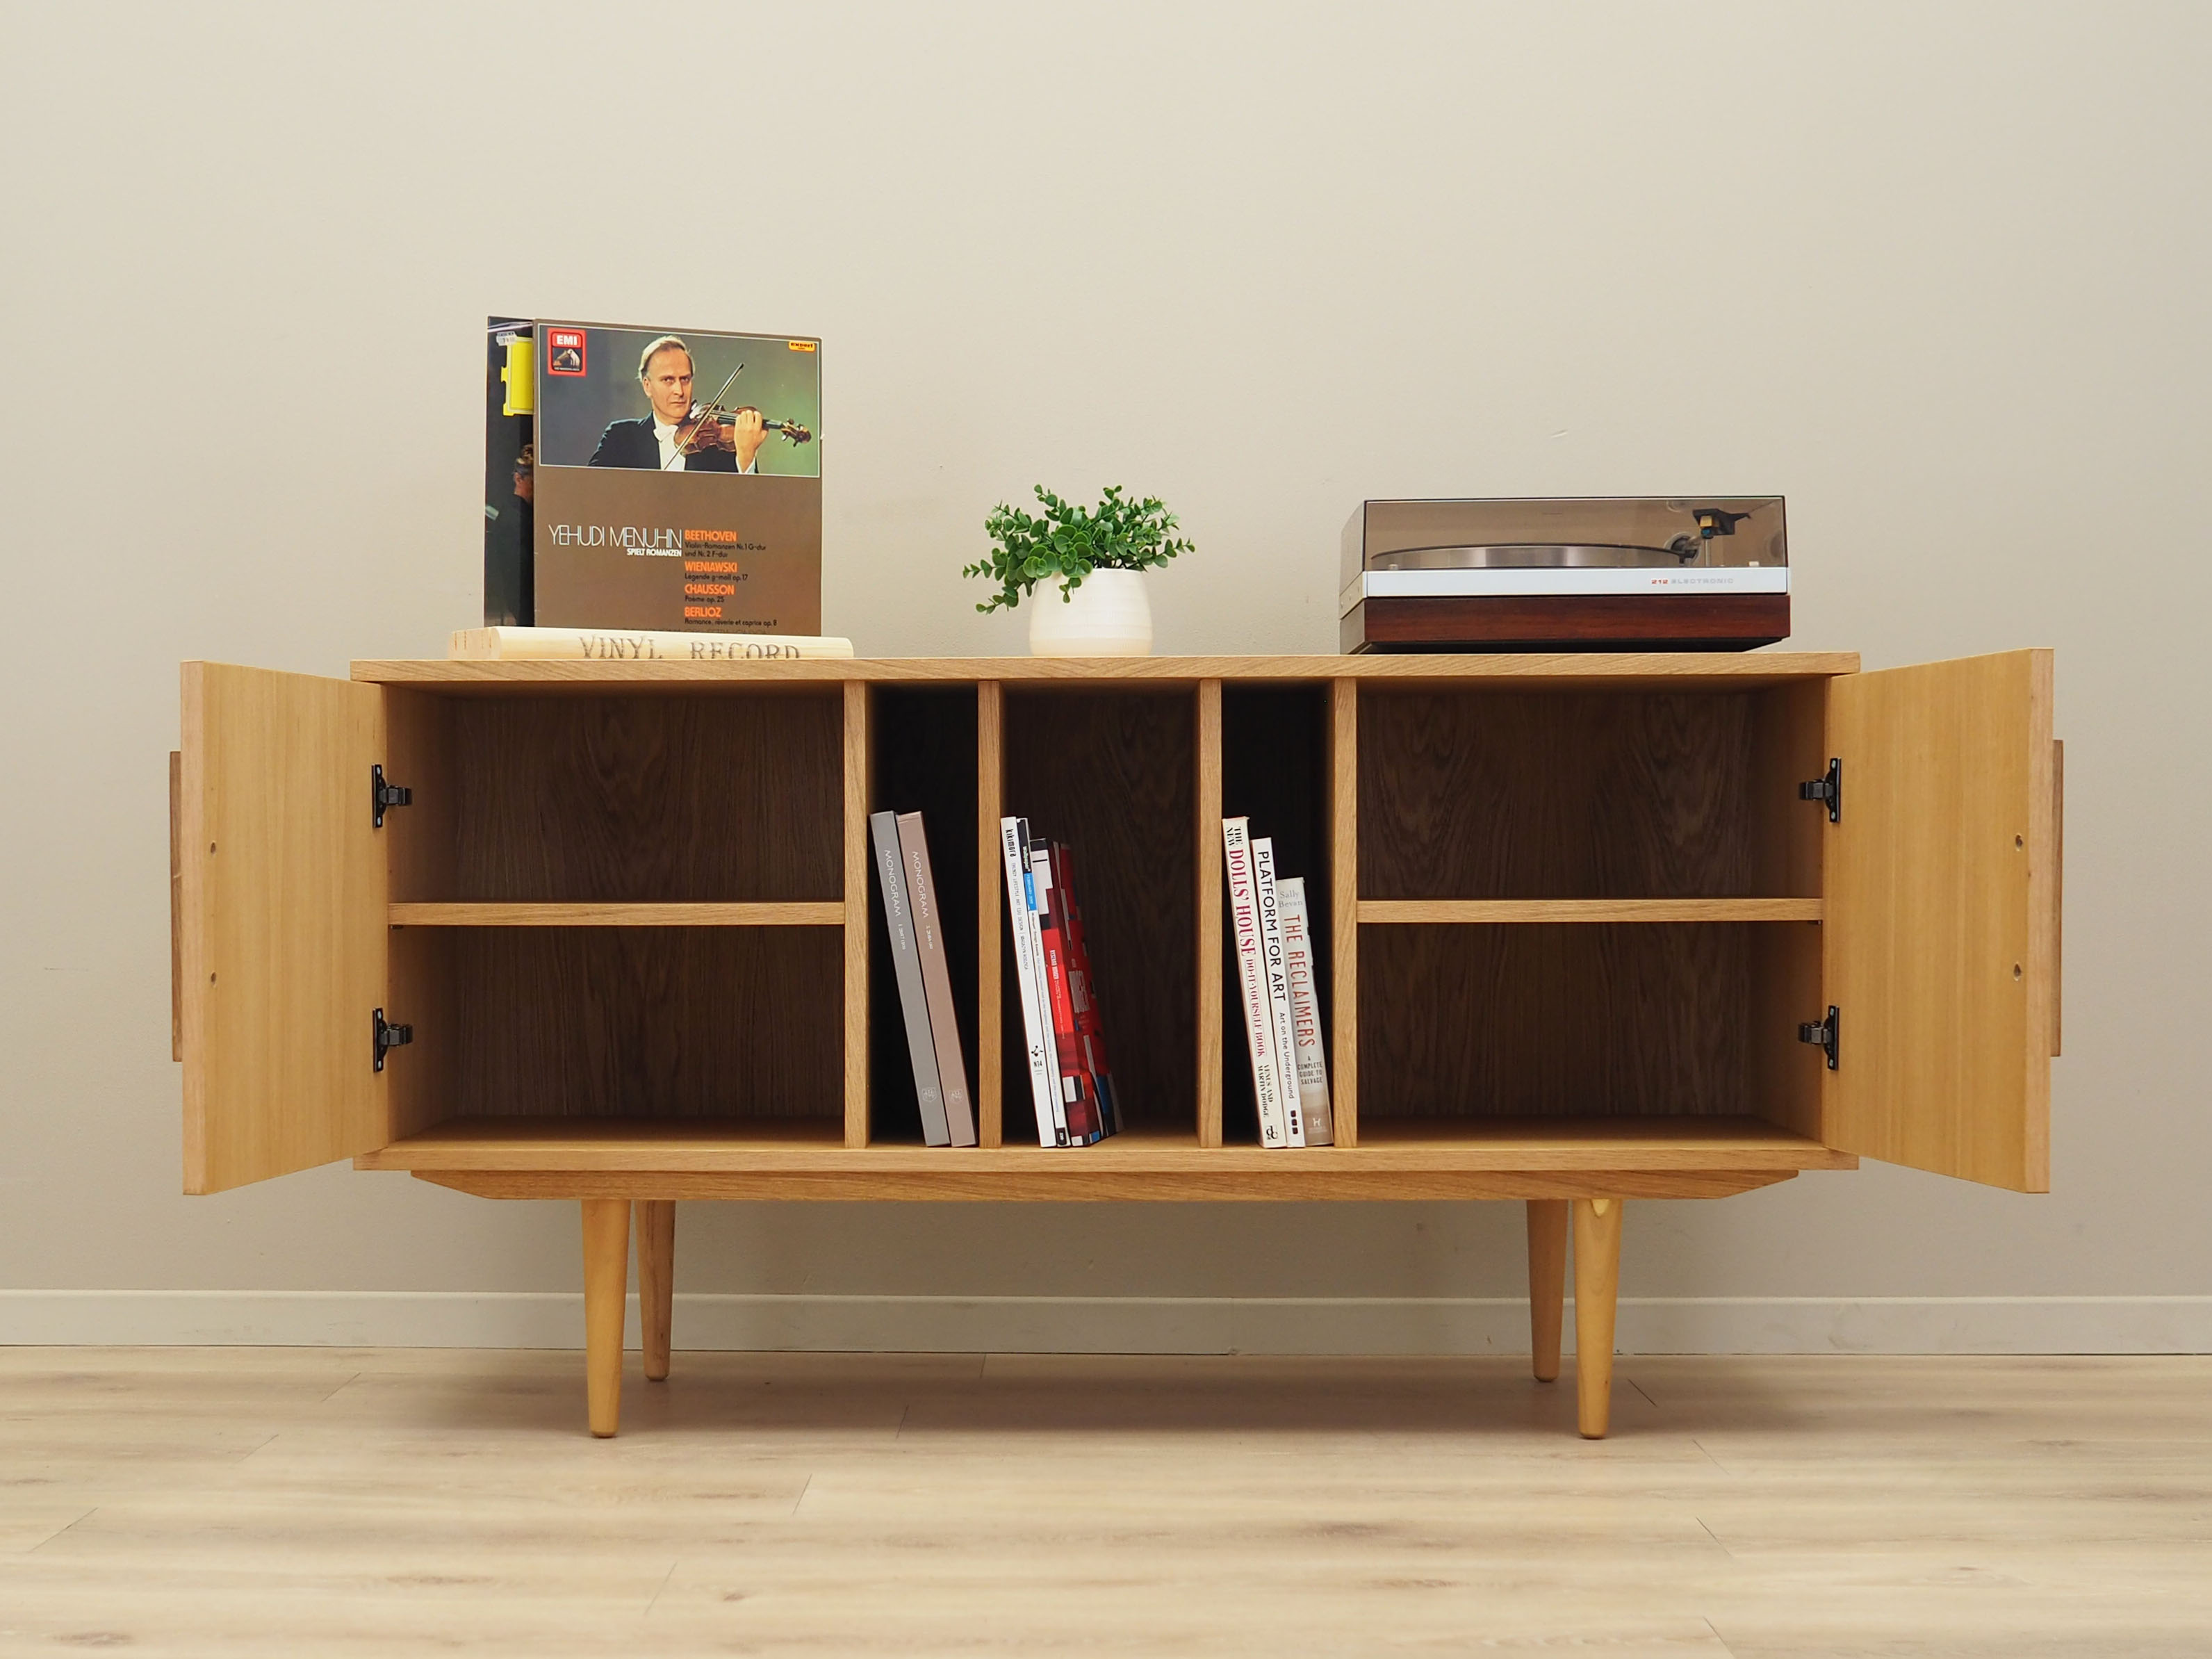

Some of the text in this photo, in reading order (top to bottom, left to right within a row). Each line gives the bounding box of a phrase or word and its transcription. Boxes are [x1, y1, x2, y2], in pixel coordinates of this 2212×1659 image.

[557, 335, 577, 345] EMI
[548, 524, 682, 548] YEHUDI MENUHIN
[685, 530, 737, 541] BEETHOVEN
[627, 548, 682, 557] SPIELT ROMANZEN
[685, 561, 737, 573] WIENIAWSKI
[685, 584, 735, 595] CHAUSSON
[685, 607, 721, 618] BERLIOZ
[579, 633, 801, 660] VINYL RECORD
[1006, 828, 1017, 858] kikimora
[1226, 827, 1236, 846] NEW
[1234, 826, 1243, 845] THE
[884, 849, 901, 917] MONOGRAM
[912, 851, 929, 918] MONOGRAM
[1279, 890, 1300, 899] Sally
[1279, 900, 1303, 908] Bevan
[1258, 851, 1286, 1001] PLATFORM FOR ART
[1236, 905, 1256, 957] HOUSE
[1255, 1032, 1265, 1057] BOOK
[1284, 914, 1316, 1047] THE RECLAIMERS
[1281, 1026, 1286, 1035] on
[1284, 1052, 1295, 1100] Underground
[1297, 1061, 1323, 1071] COMPLETE
